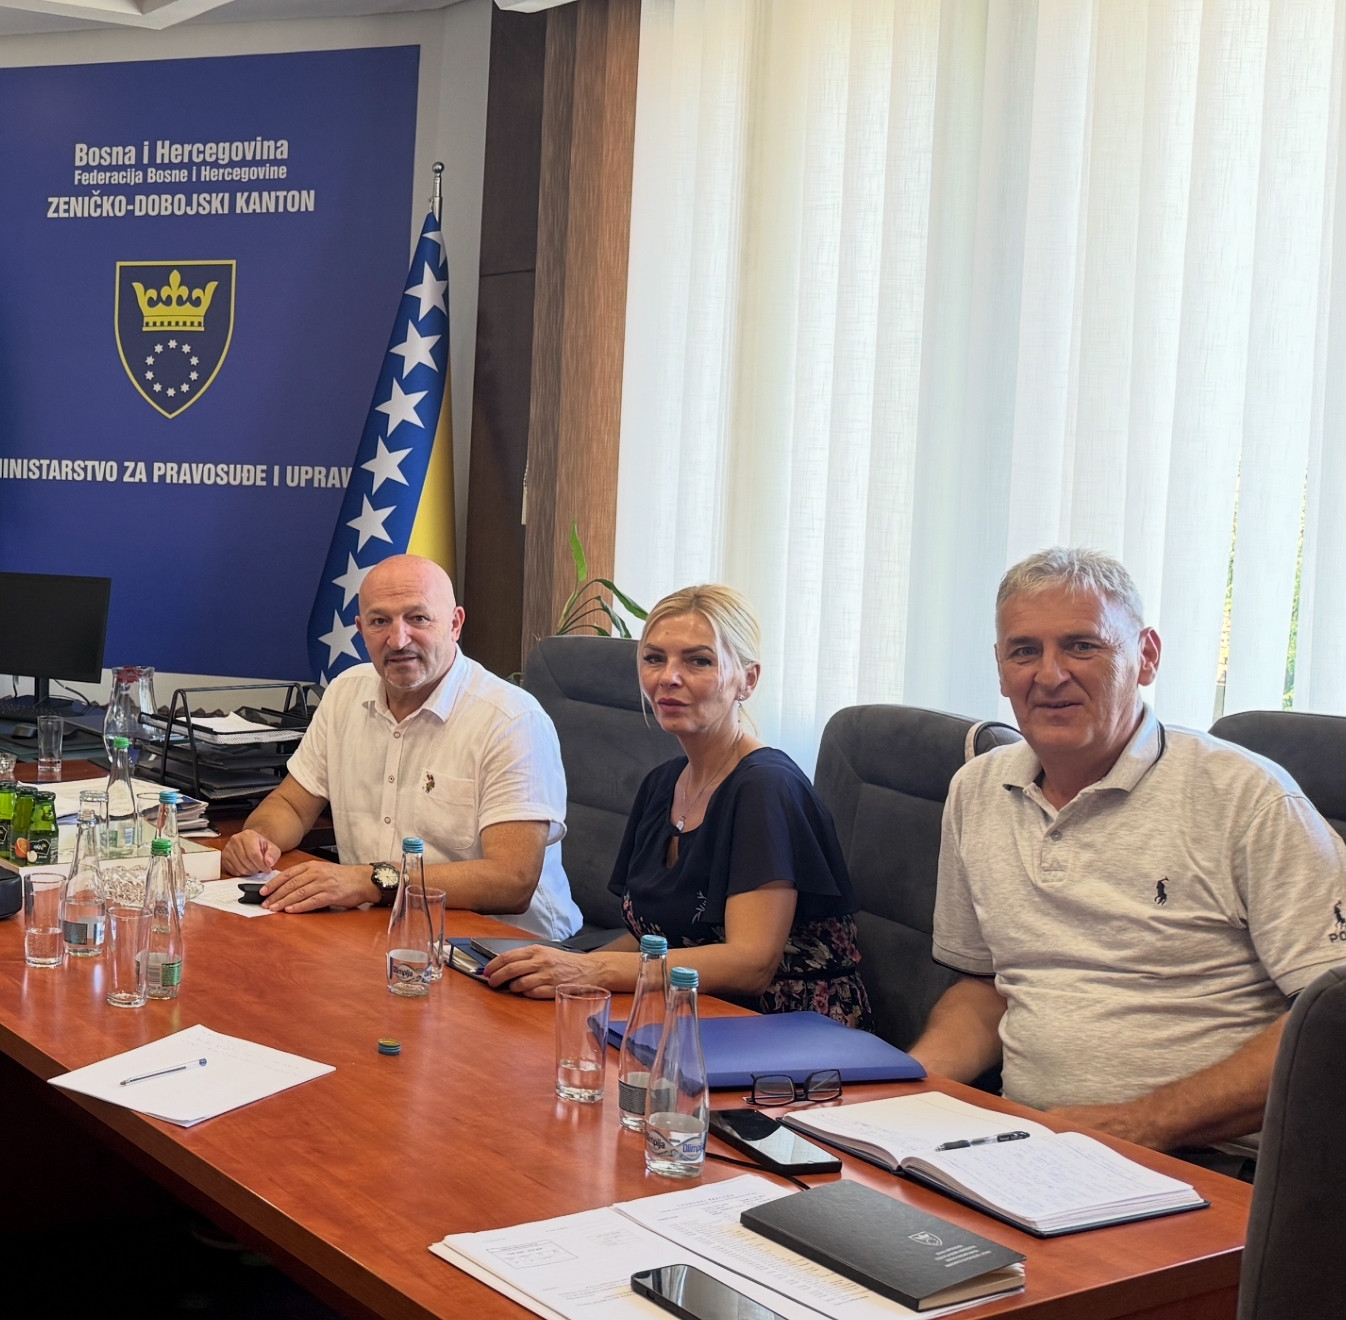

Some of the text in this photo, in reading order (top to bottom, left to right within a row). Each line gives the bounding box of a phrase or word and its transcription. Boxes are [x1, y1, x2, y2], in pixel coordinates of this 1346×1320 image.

[75, 136, 289, 167] Bosna i Hercegovina
[74, 163, 288, 185] Federacija Bosne i Hercegovine
[46, 189, 315, 218] ZENIČKO-DOBOJSKI KANTON
[122, 461, 148, 483] ZA
[152, 462, 267, 487] PRAVOSUĐE
[273, 465, 280, 487] I
[286, 465, 353, 489] UPRAV
[1328, 930, 1346, 943] PO
